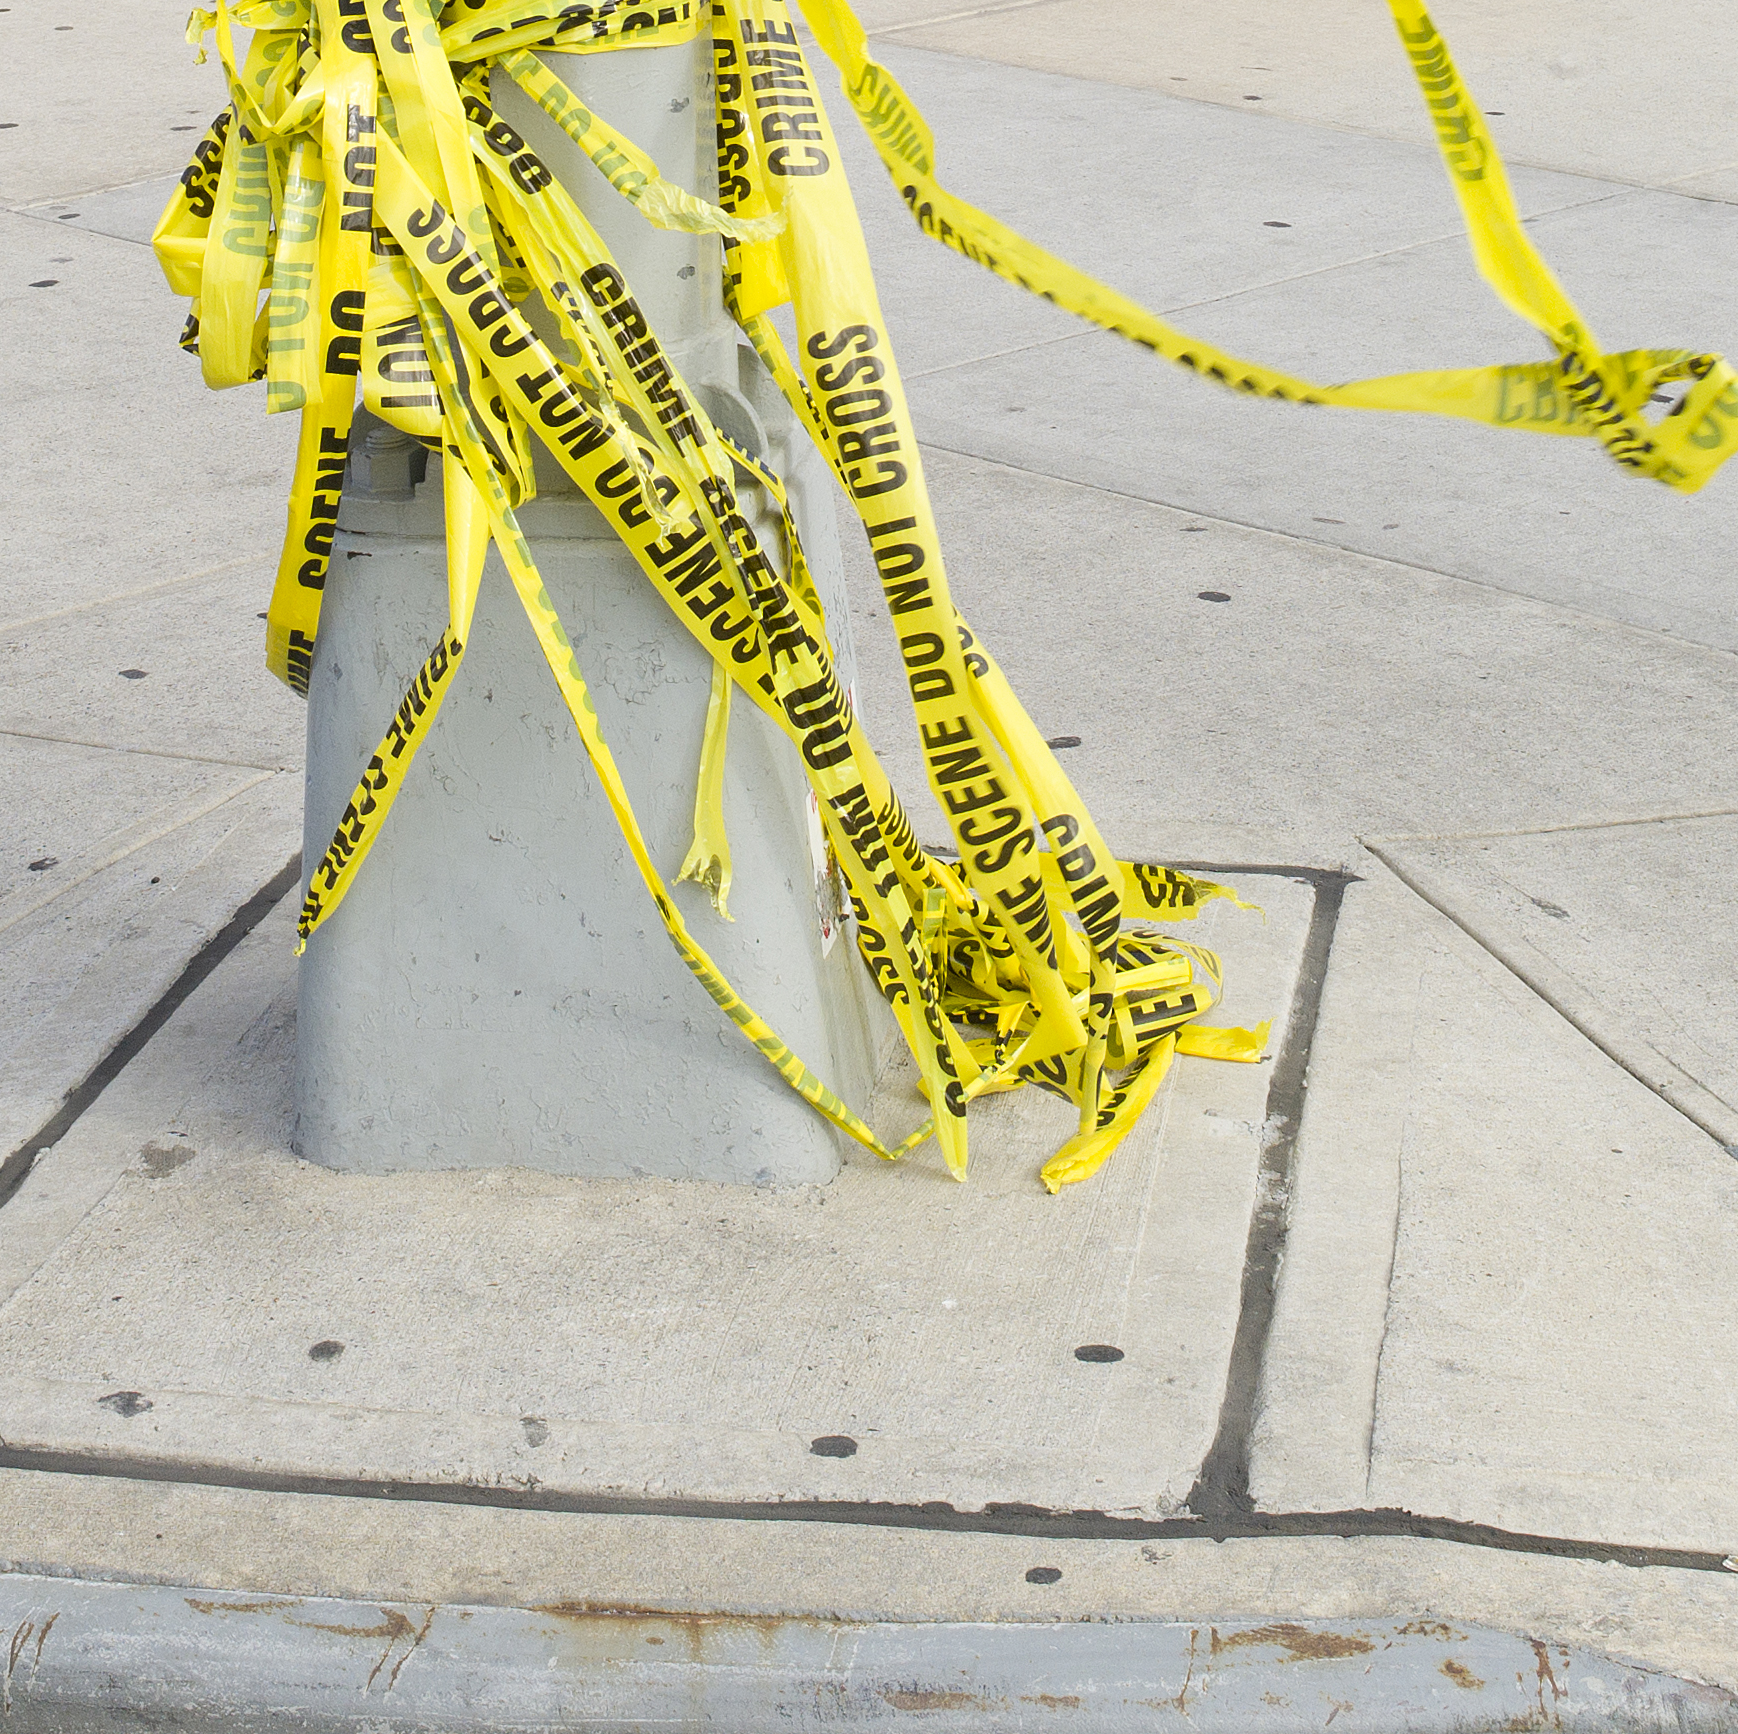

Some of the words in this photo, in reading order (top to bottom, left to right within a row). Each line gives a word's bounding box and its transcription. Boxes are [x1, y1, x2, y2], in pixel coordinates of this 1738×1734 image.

[740, 18, 831, 177] CRIME
[406, 197, 542, 358] CROSS
[516, 362, 617, 462] NOT
[806, 323, 909, 500] CROSS
[579, 262, 709, 459] CRIME
[782, 677, 854, 771] DO
[862, 515, 935, 616] NOT
[899, 630, 957, 703] DO
[920, 715, 1036, 876] SCENE
